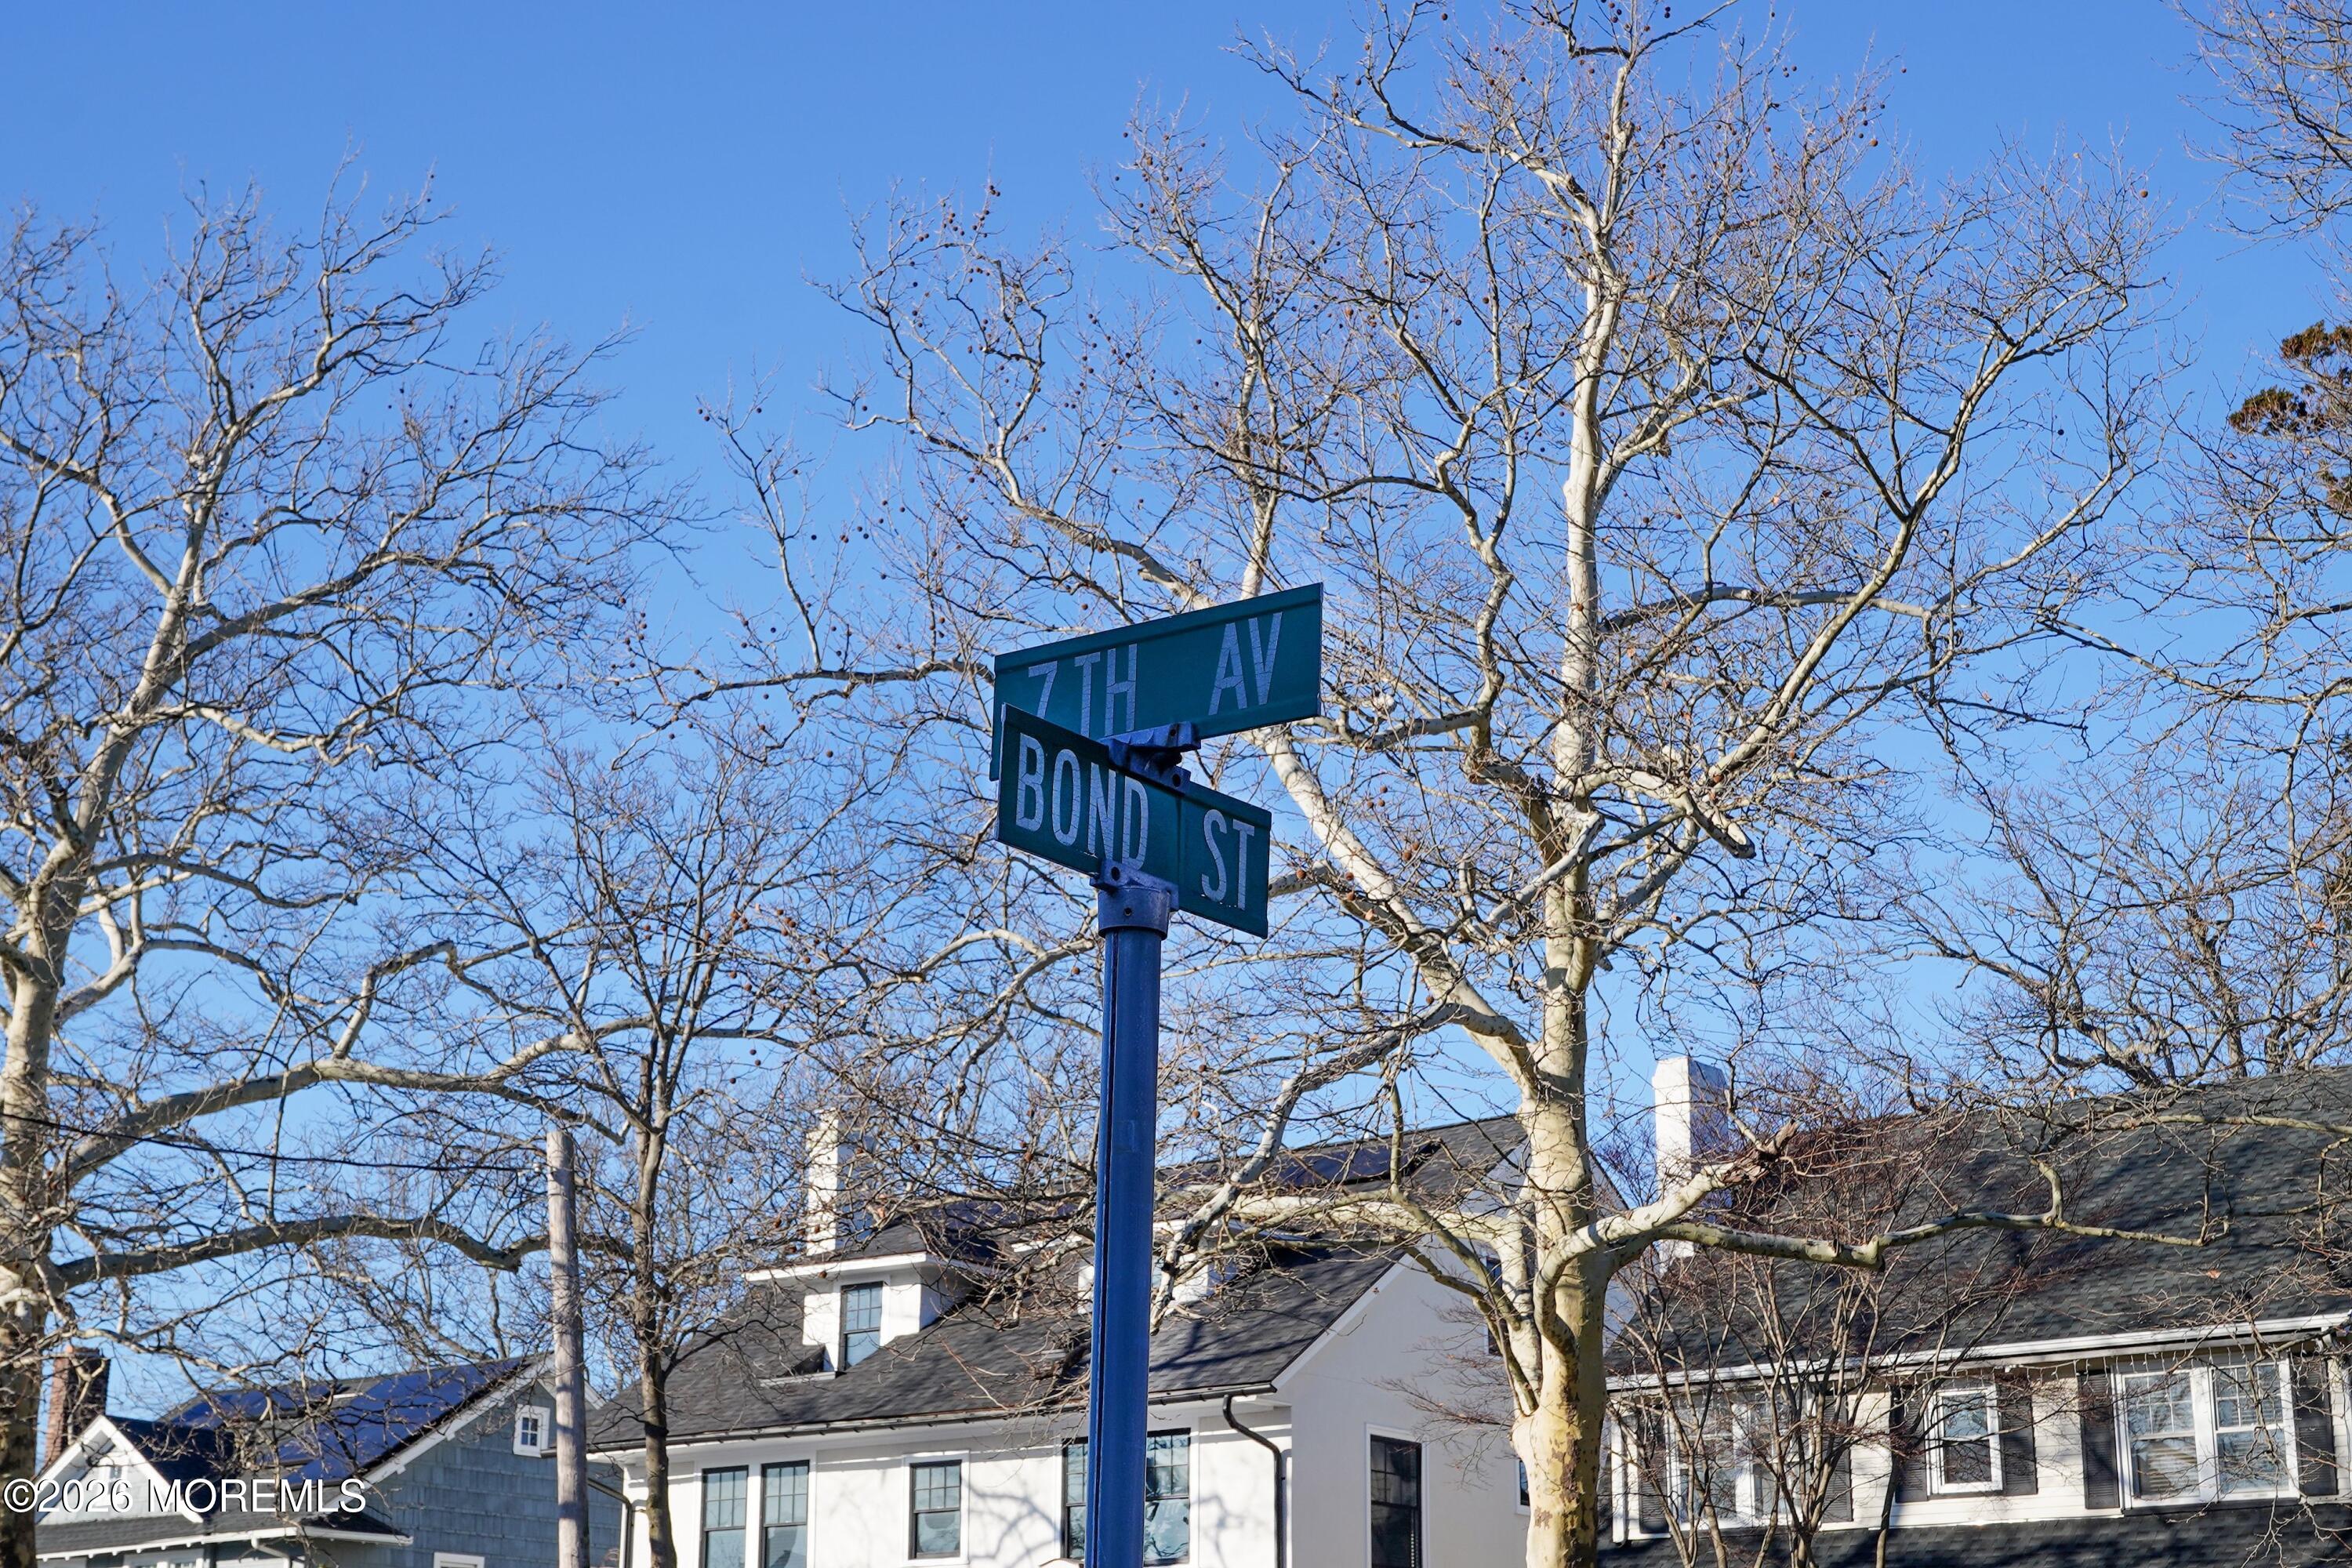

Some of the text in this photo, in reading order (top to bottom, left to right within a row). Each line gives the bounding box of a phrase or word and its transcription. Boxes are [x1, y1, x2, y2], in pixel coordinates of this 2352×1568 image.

[1208, 612, 1283, 715] AV
[1015, 732, 1255, 910] BOND ST
